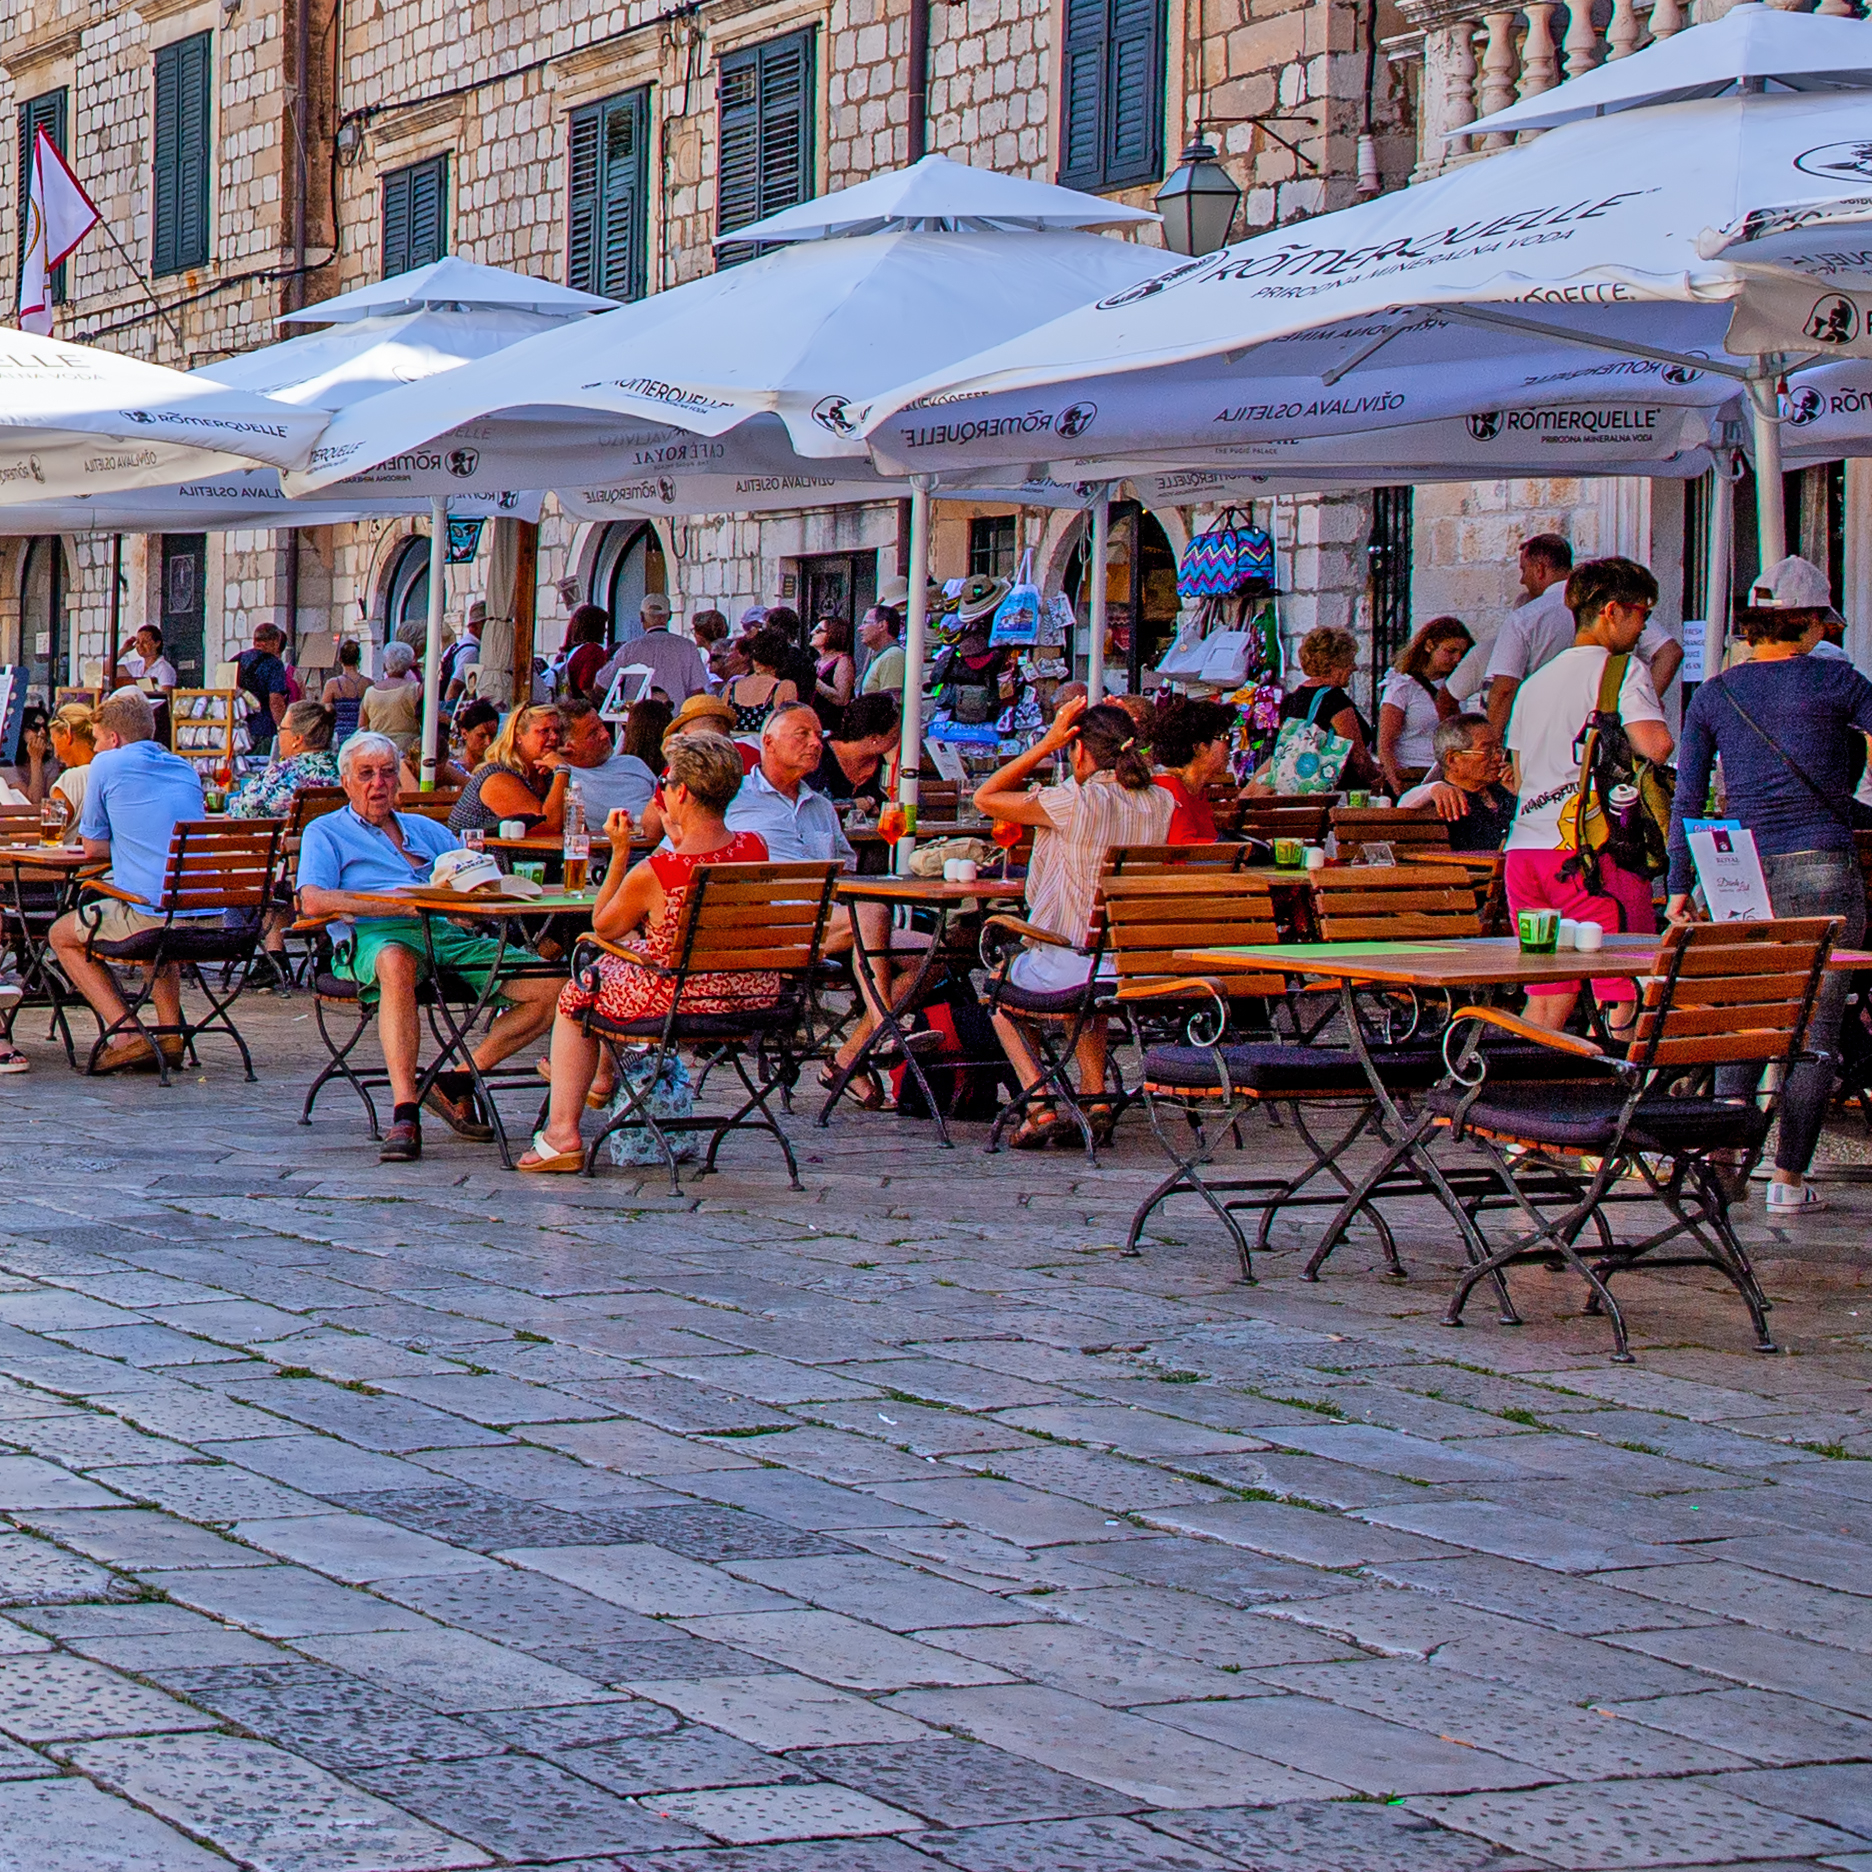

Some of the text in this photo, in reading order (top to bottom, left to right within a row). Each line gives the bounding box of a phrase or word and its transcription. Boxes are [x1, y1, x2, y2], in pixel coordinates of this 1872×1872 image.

[1251, 229, 1576, 299] PRIRODNA MINERALNA VODA
[48, 371, 107, 383] VODA
[1540, 433, 1654, 445] PRIRODNA MINERALNA VODA
